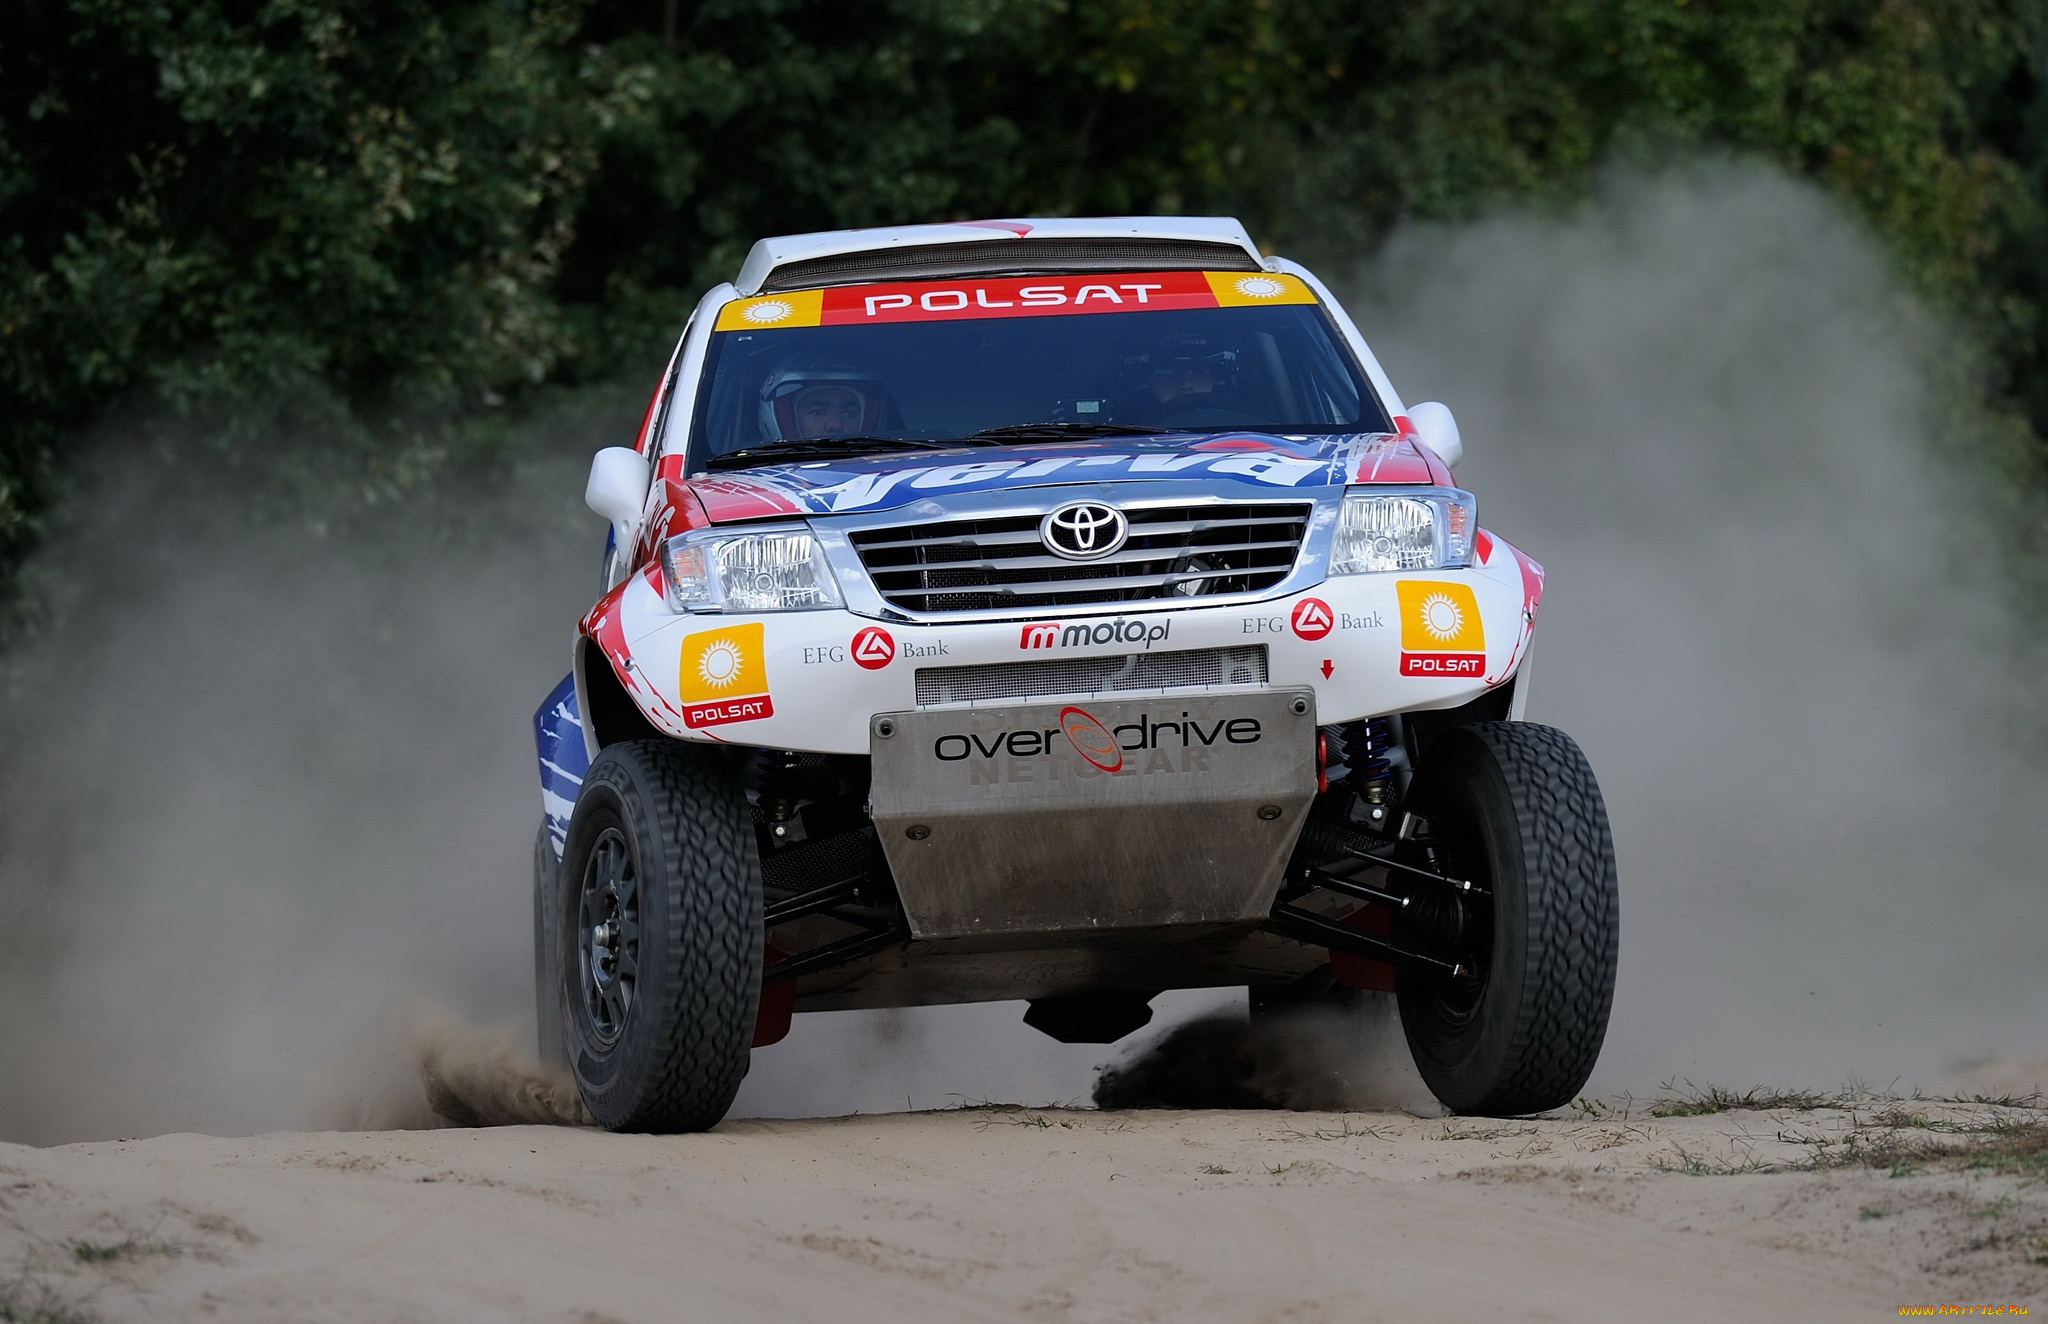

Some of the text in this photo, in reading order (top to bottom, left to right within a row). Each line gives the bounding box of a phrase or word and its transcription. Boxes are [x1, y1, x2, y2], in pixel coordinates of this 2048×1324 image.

[864, 284, 1162, 317] POLSAT
[1242, 613, 1384, 634] EFG Bank
[802, 640, 949, 664] EFG Bank
[1408, 659, 1480, 672] POLSAT
[691, 702, 764, 724] POLSAT
